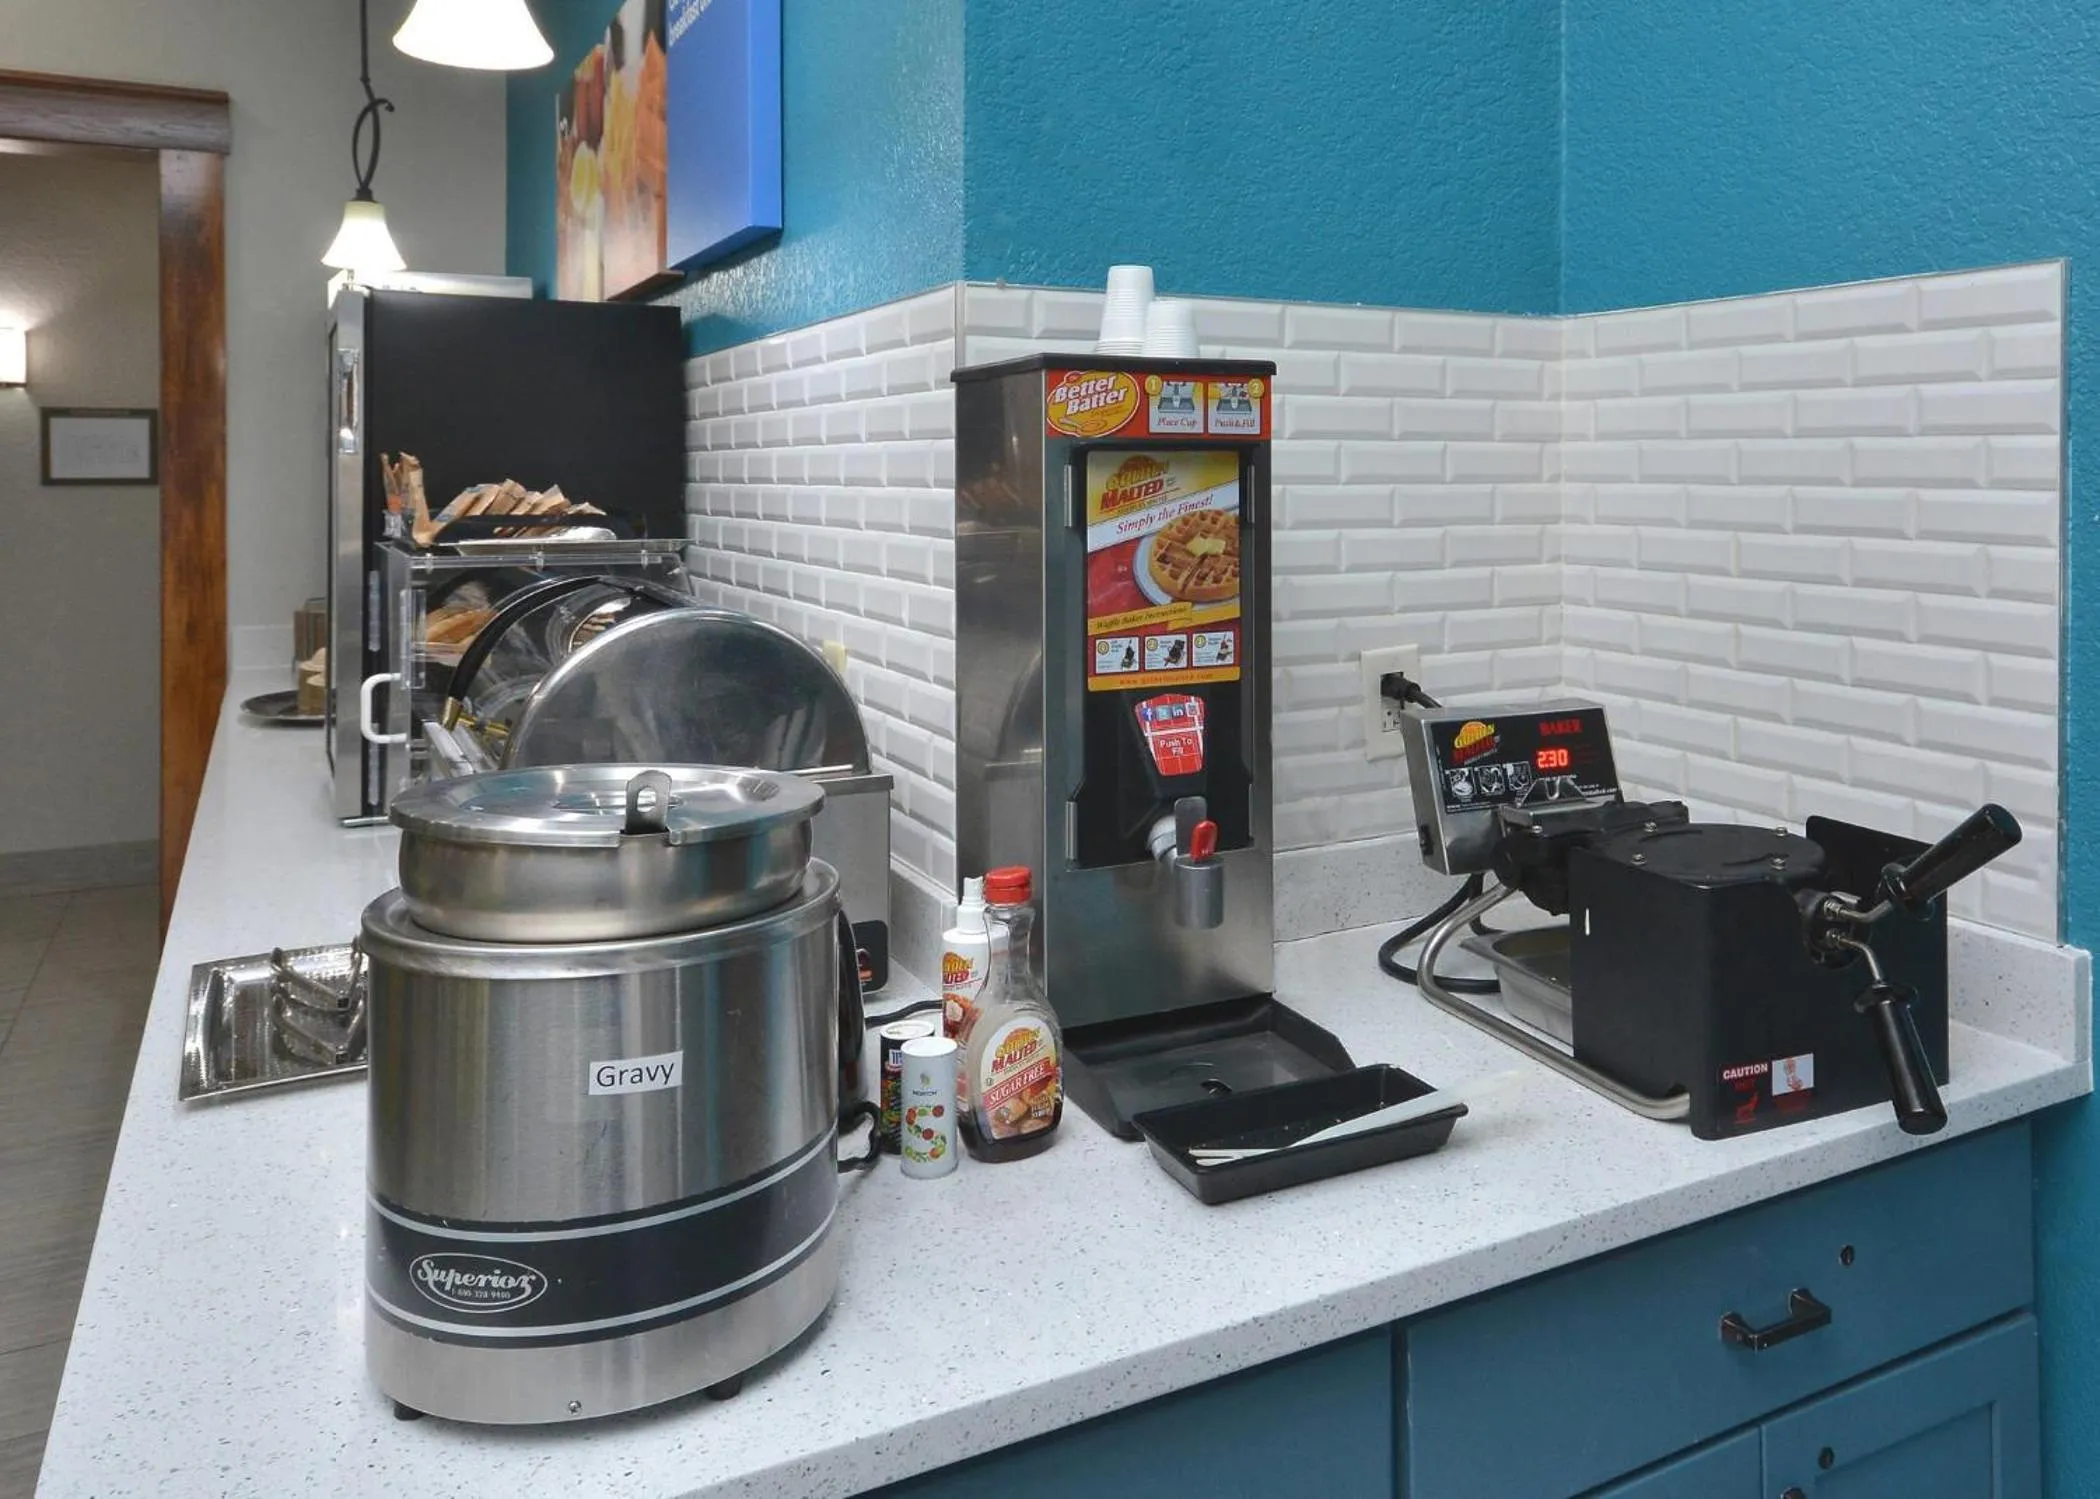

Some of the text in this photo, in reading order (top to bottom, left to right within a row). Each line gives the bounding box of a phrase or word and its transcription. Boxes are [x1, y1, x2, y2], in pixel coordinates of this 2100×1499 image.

[1055, 375, 1117, 403] Better
[1066, 387, 1128, 415] Batter
[1101, 479, 1165, 510] MALTED
[1116, 512, 1157, 535] Simply
[1158, 506, 1176, 521] the
[1177, 493, 1214, 515] Finest!
[1536, 748, 1569, 769] 230
[991, 1040, 1037, 1073] MALTED
[597, 1062, 674, 1087] Gravy
[989, 1077, 1022, 1106] SUGAR
[1022, 1063, 1046, 1085] FREE
[1723, 1063, 1768, 1080] CAUTION
[416, 1259, 537, 1293] Superior
